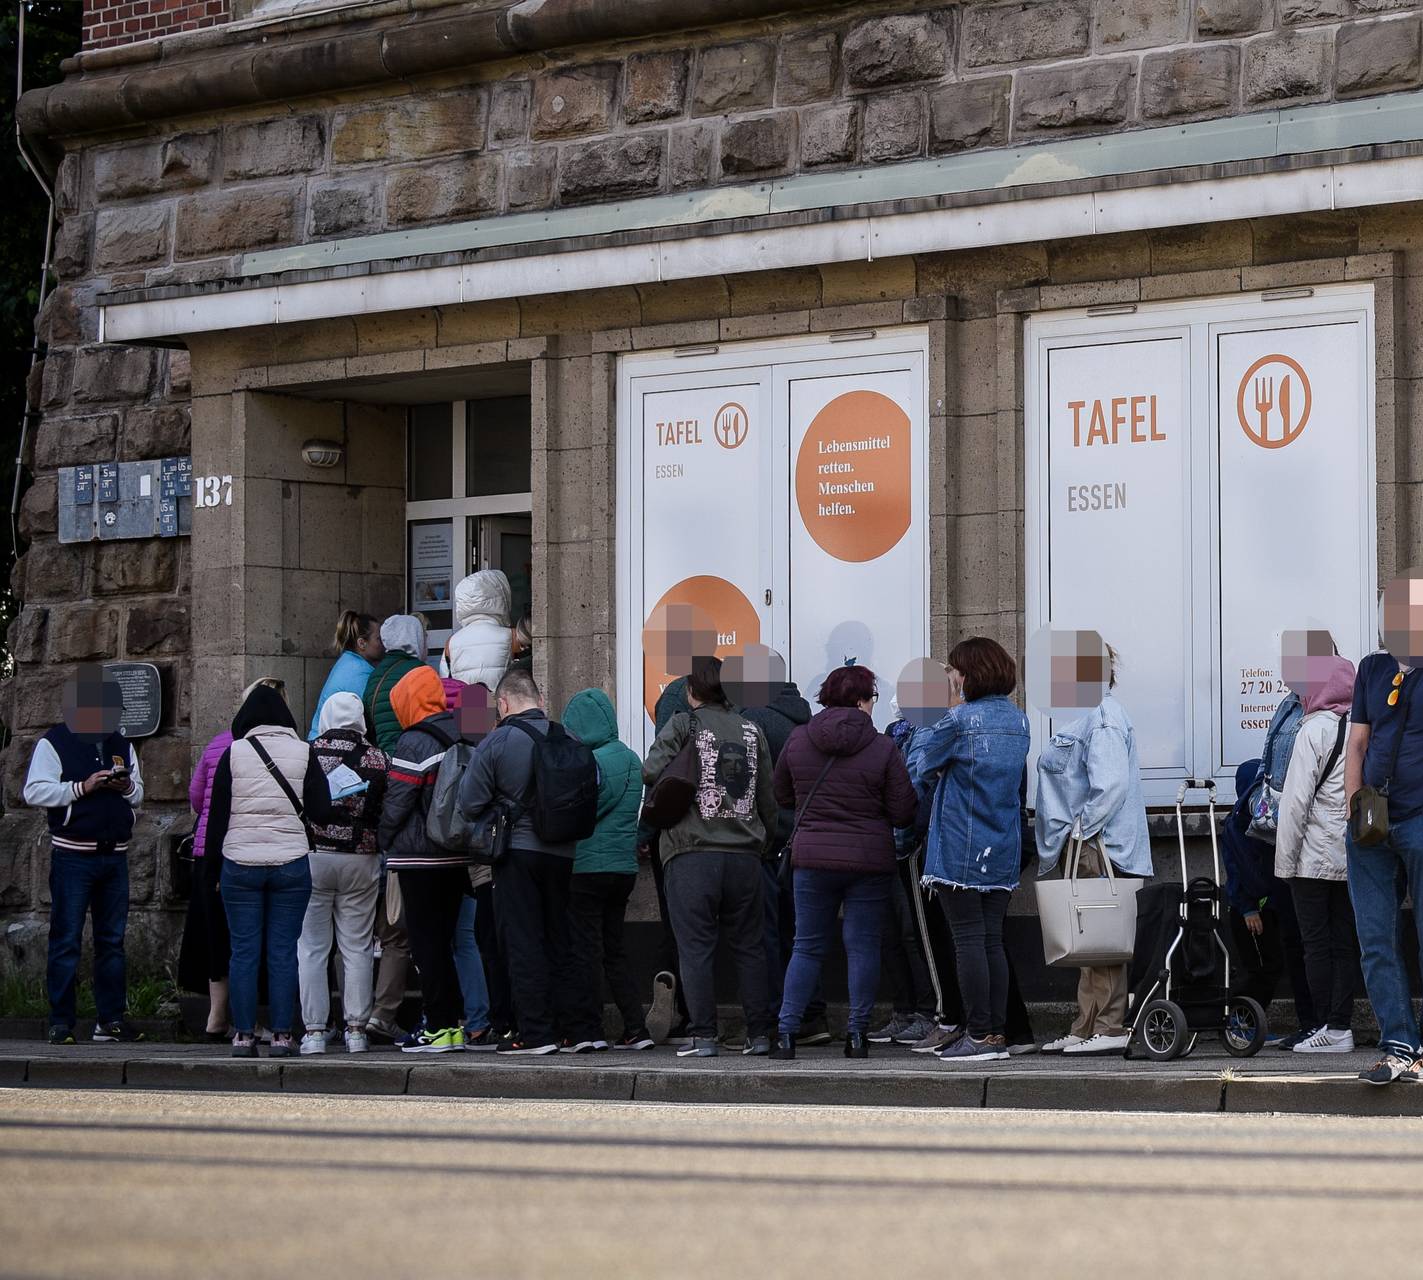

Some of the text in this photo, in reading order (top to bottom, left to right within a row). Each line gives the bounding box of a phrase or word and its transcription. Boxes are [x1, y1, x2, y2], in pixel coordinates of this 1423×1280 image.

[1068, 395, 1166, 446] TAFEL
[656, 420, 703, 446] TAFEL
[818, 436, 890, 454] Lebensmittel
[655, 463, 684, 479] ESSEN
[818, 460, 854, 474] retten.
[195, 475, 233, 508] 137
[818, 480, 874, 495] Menschen
[1068, 483, 1127, 513] ESSEN
[818, 502, 856, 516] helfen.
[1241, 668, 1273, 678] Telefon:
[1241, 682, 1255, 694] 27
[1259, 681, 1273, 693] 20
[1241, 703, 1277, 713] Internet:
